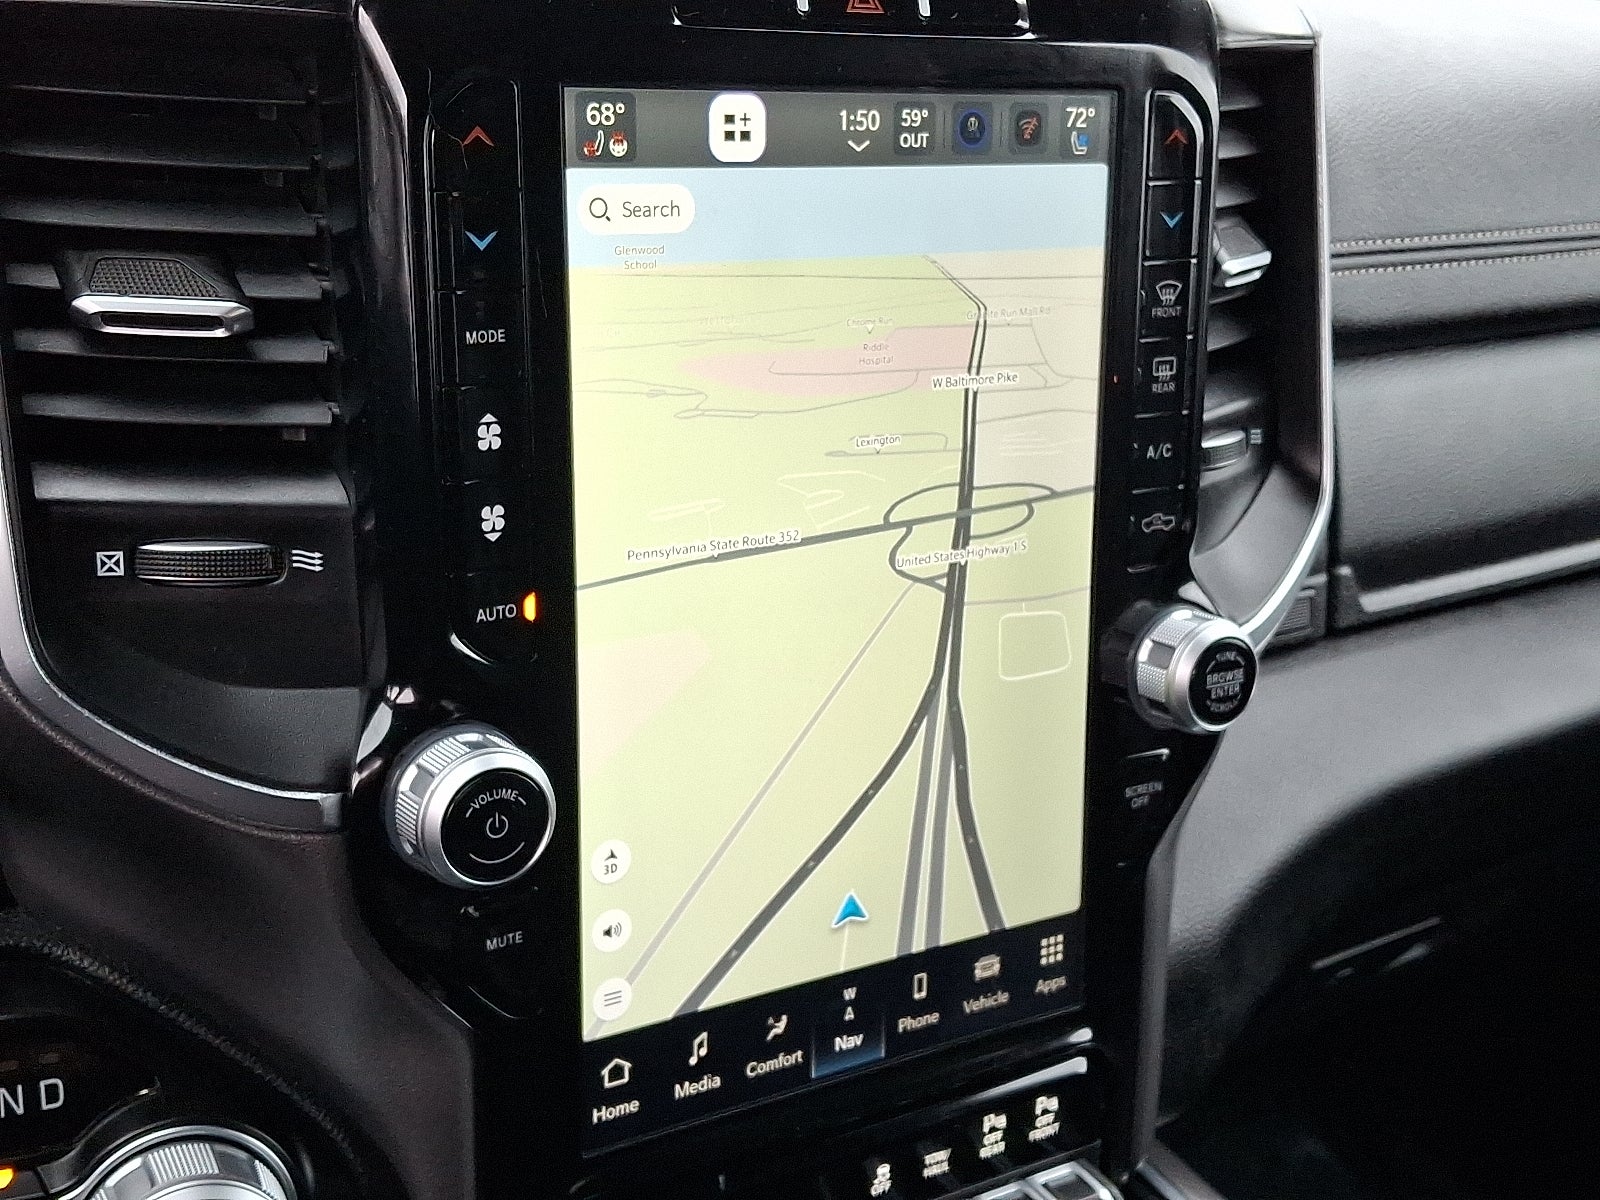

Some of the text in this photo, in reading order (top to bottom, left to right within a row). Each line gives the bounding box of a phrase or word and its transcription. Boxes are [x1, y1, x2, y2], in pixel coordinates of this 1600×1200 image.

[839, 109, 881, 131] 1:50
[900, 133, 929, 149] OUT
[621, 199, 681, 219] Search
[614, 245, 665, 256] Glenwood
[624, 260, 657, 270] School
[1151, 306, 1182, 318] FRONT
[466, 329, 506, 345] MODE
[859, 355, 894, 366] Hospital
[932, 371, 1018, 389] W Baltimore Pike
[1152, 382, 1175, 393] REAR
[855, 434, 901, 449] Lexington
[1146, 443, 1172, 460] A/C
[627, 529, 800, 561] Pennsylvania State Route 352
[897, 554, 931, 568] United
[933, 551, 964, 564] States
[966, 545, 1010, 559] Highway
[476, 603, 517, 624] AUTO
[1206, 668, 1244, 686] BROWSE
[1211, 682, 1240, 699] ENTER
[470, 787, 519, 810] VOLUME
[603, 863, 618, 876] 3D
[486, 931, 524, 951] MUTE
[843, 986, 857, 1001] W
[1035, 976, 1067, 994] Apps
[963, 990, 1010, 1014] Vehicle
[898, 1011, 940, 1034] Phone
[834, 1033, 864, 1052] Nav
[746, 1049, 804, 1078] Comfort
[674, 1073, 721, 1100] Media
[0, 1078, 65, 1118] N D
[592, 1099, 640, 1125] Home
